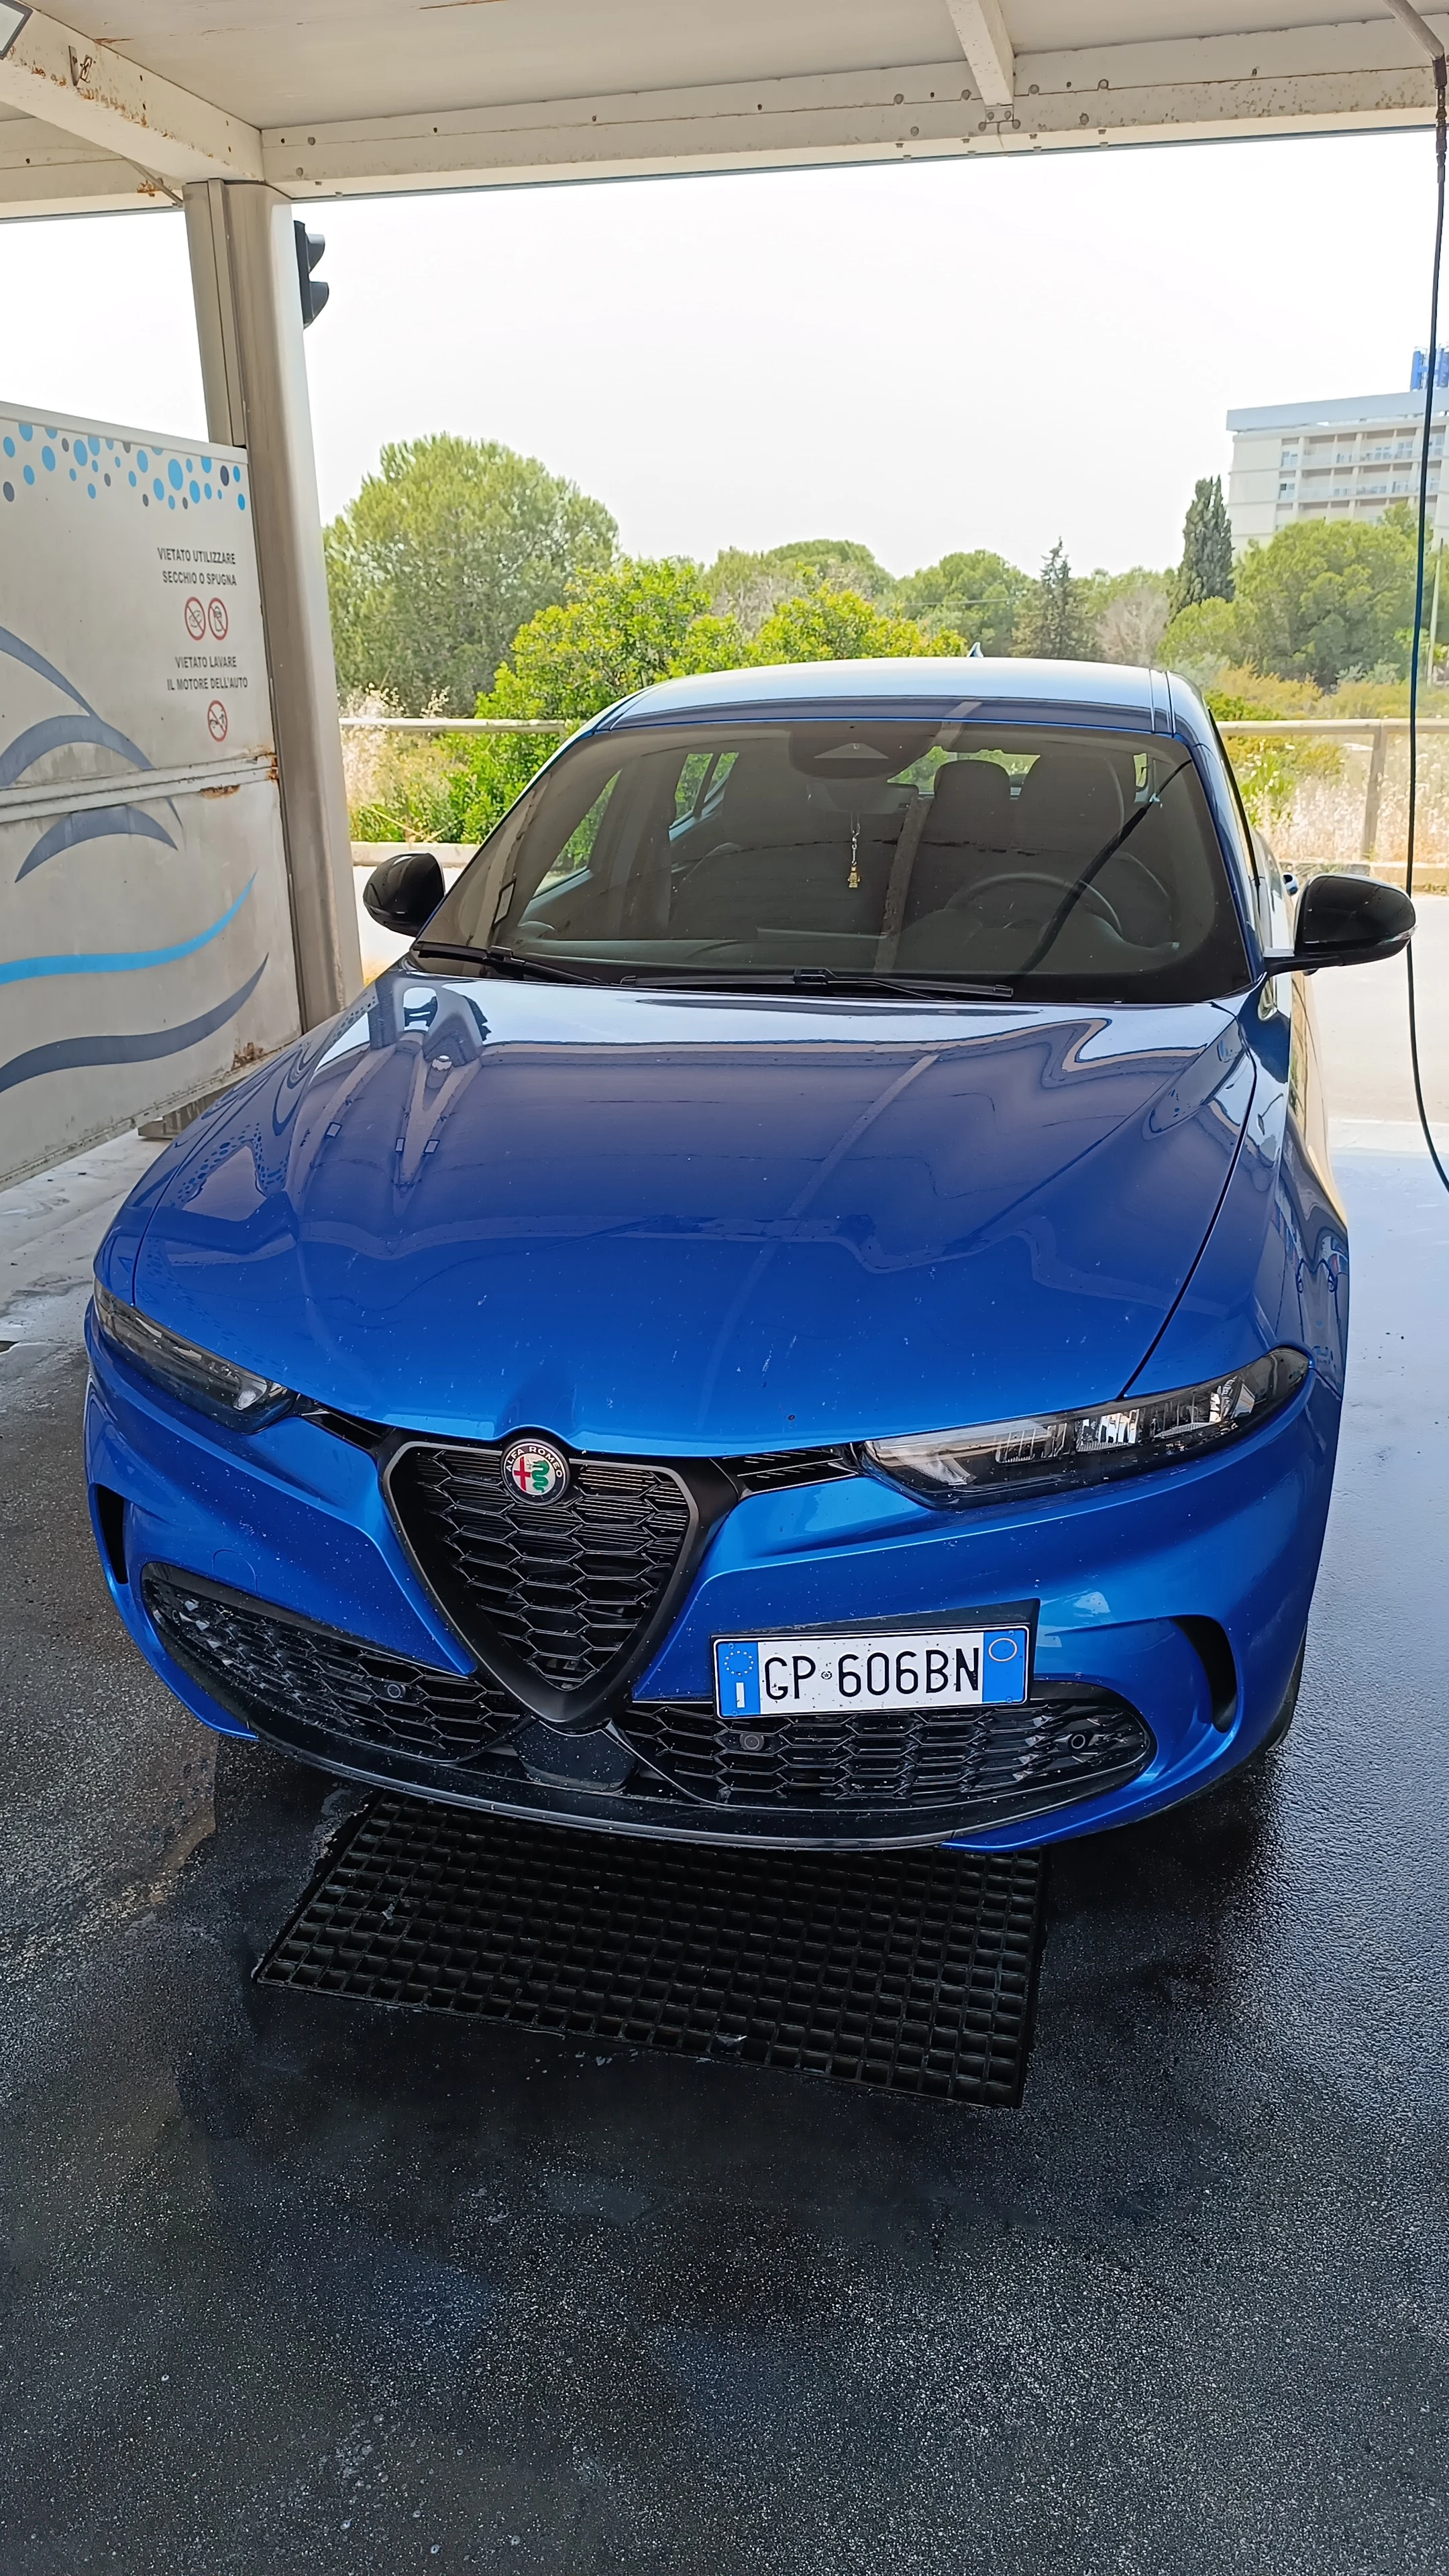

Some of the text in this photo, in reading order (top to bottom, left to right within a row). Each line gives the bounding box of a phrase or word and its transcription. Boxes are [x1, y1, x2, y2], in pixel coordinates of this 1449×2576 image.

[157, 547, 235, 564] VIETATO UTILIZZARE
[162, 570, 237, 586] SECCHIO O SPUGNA
[174, 656, 237, 668] VIETATO LAVARE
[166, 677, 248, 690] IL MOTORE DELL'AUTO
[506, 1446, 563, 1478] ALFA ROMEO
[736, 1682, 745, 1708] I
